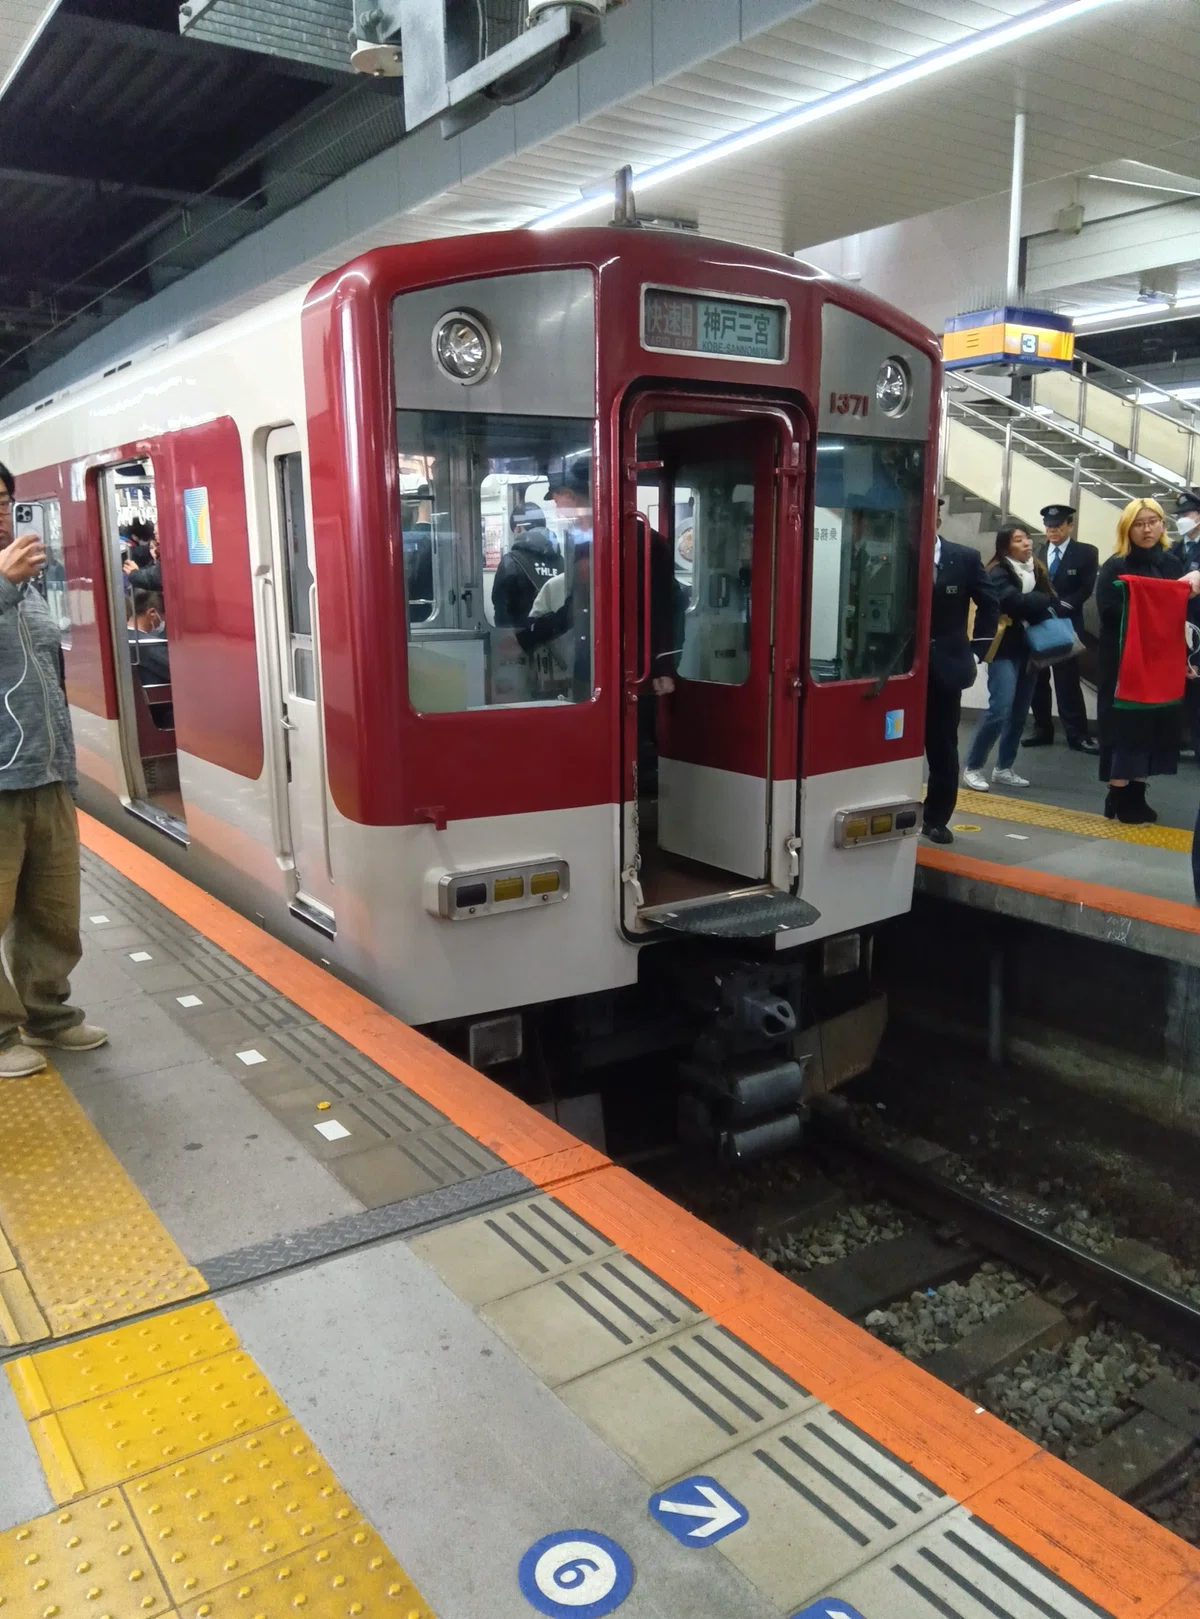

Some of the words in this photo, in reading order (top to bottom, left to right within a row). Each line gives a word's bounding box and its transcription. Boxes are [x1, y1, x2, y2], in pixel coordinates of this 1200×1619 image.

[703, 306, 771, 345] 神戸三宮
[1022, 334, 1036, 353] 3
[830, 392, 869, 417] 1371
[552, 1558, 600, 1590] 6
